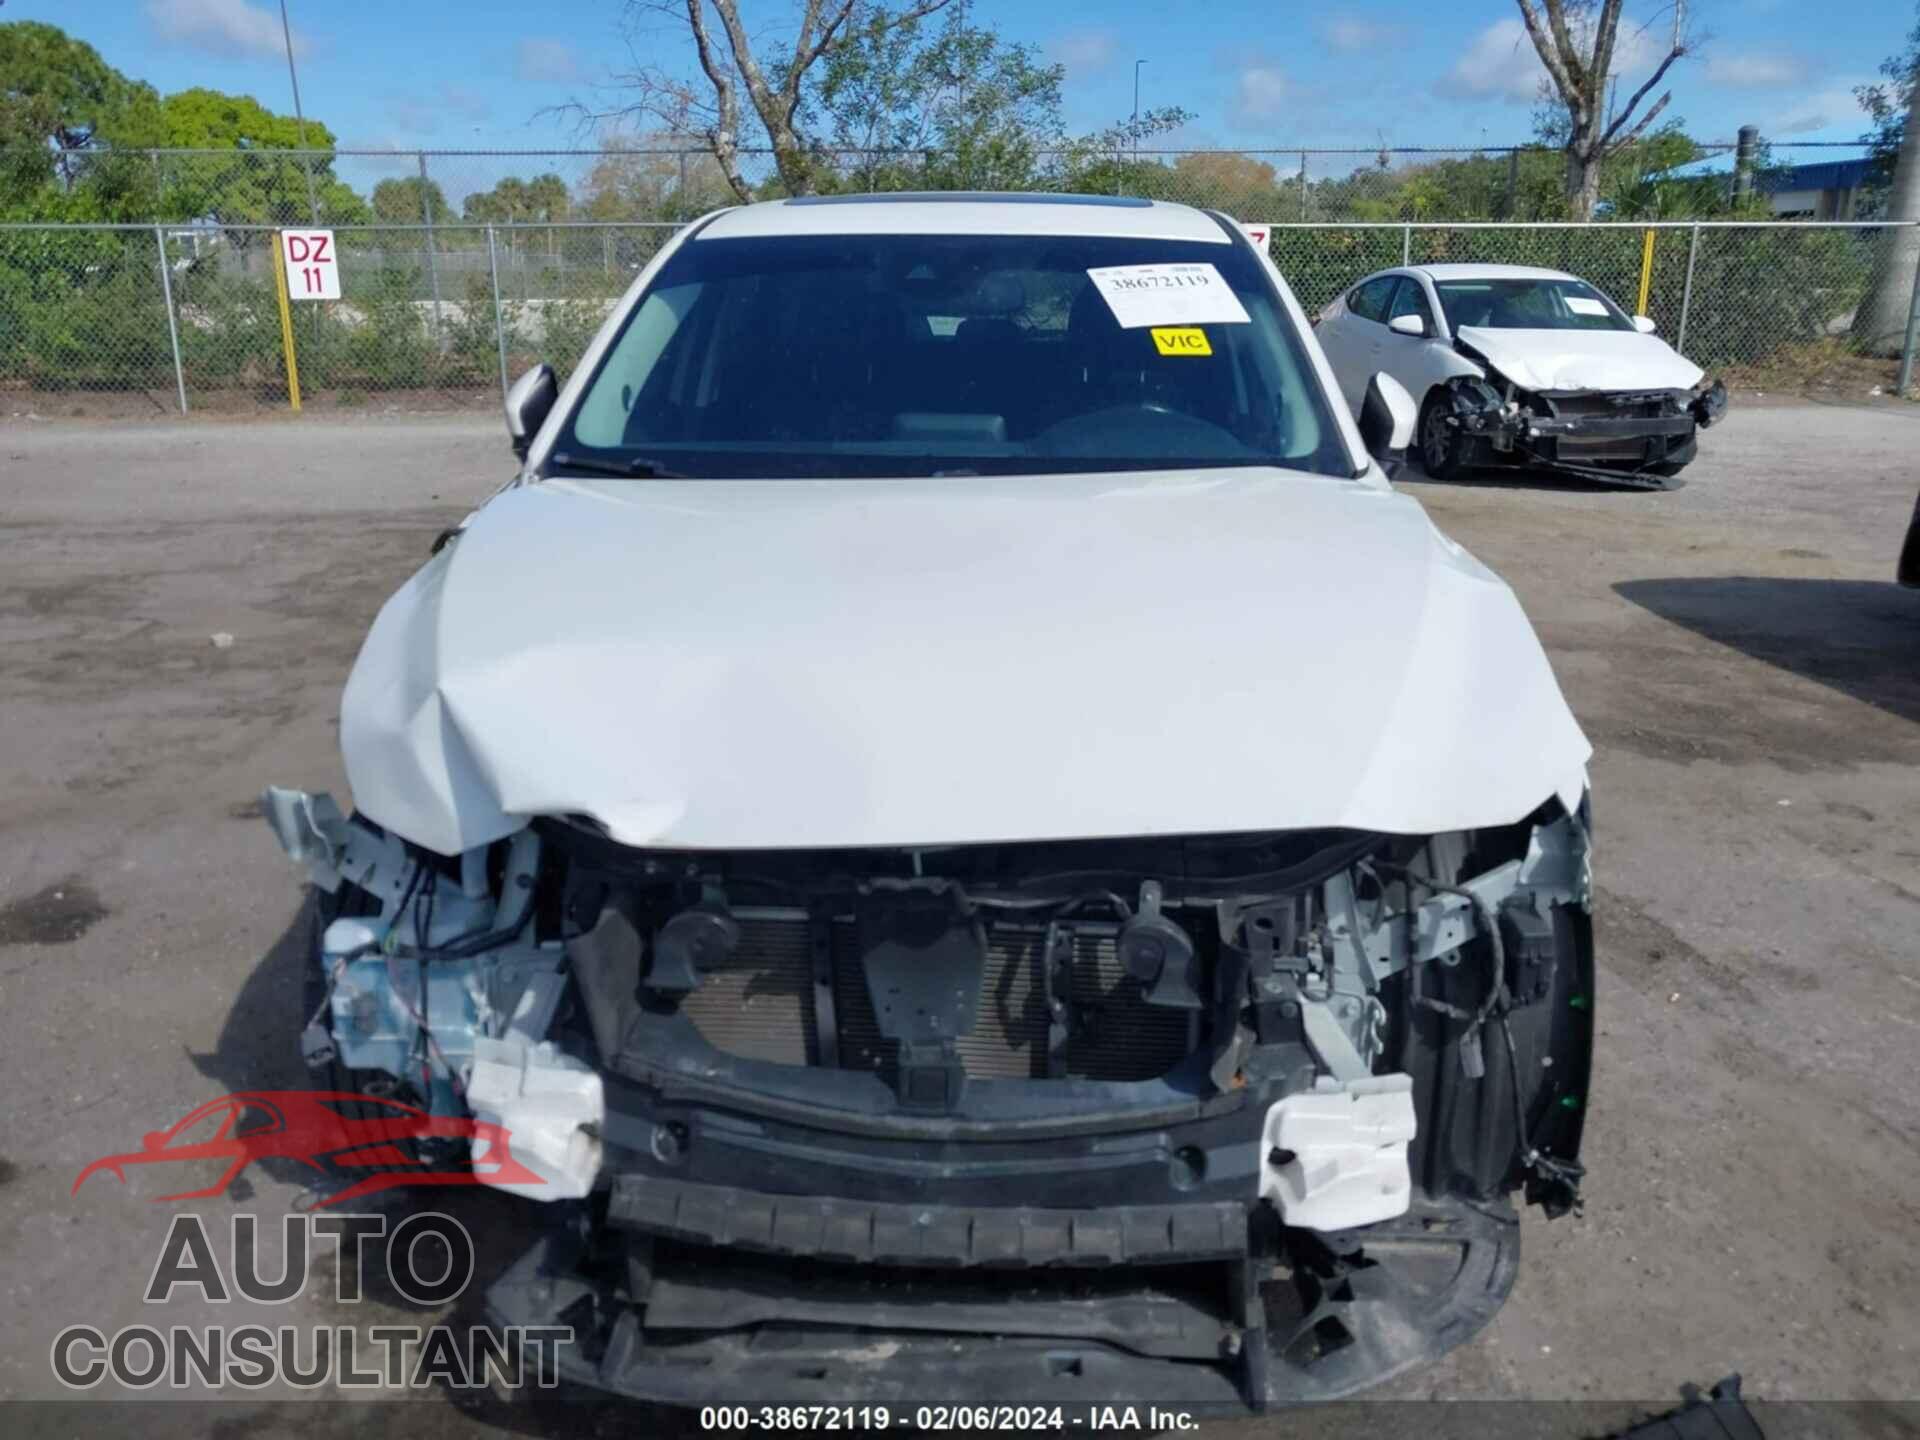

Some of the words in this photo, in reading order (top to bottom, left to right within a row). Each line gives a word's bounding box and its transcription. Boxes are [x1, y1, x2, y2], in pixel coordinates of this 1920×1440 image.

[288, 235, 332, 262] DZ
[303, 267, 322, 293] 11
[1109, 274, 1209, 291] 38672119
[1158, 334, 1204, 350] VIC
